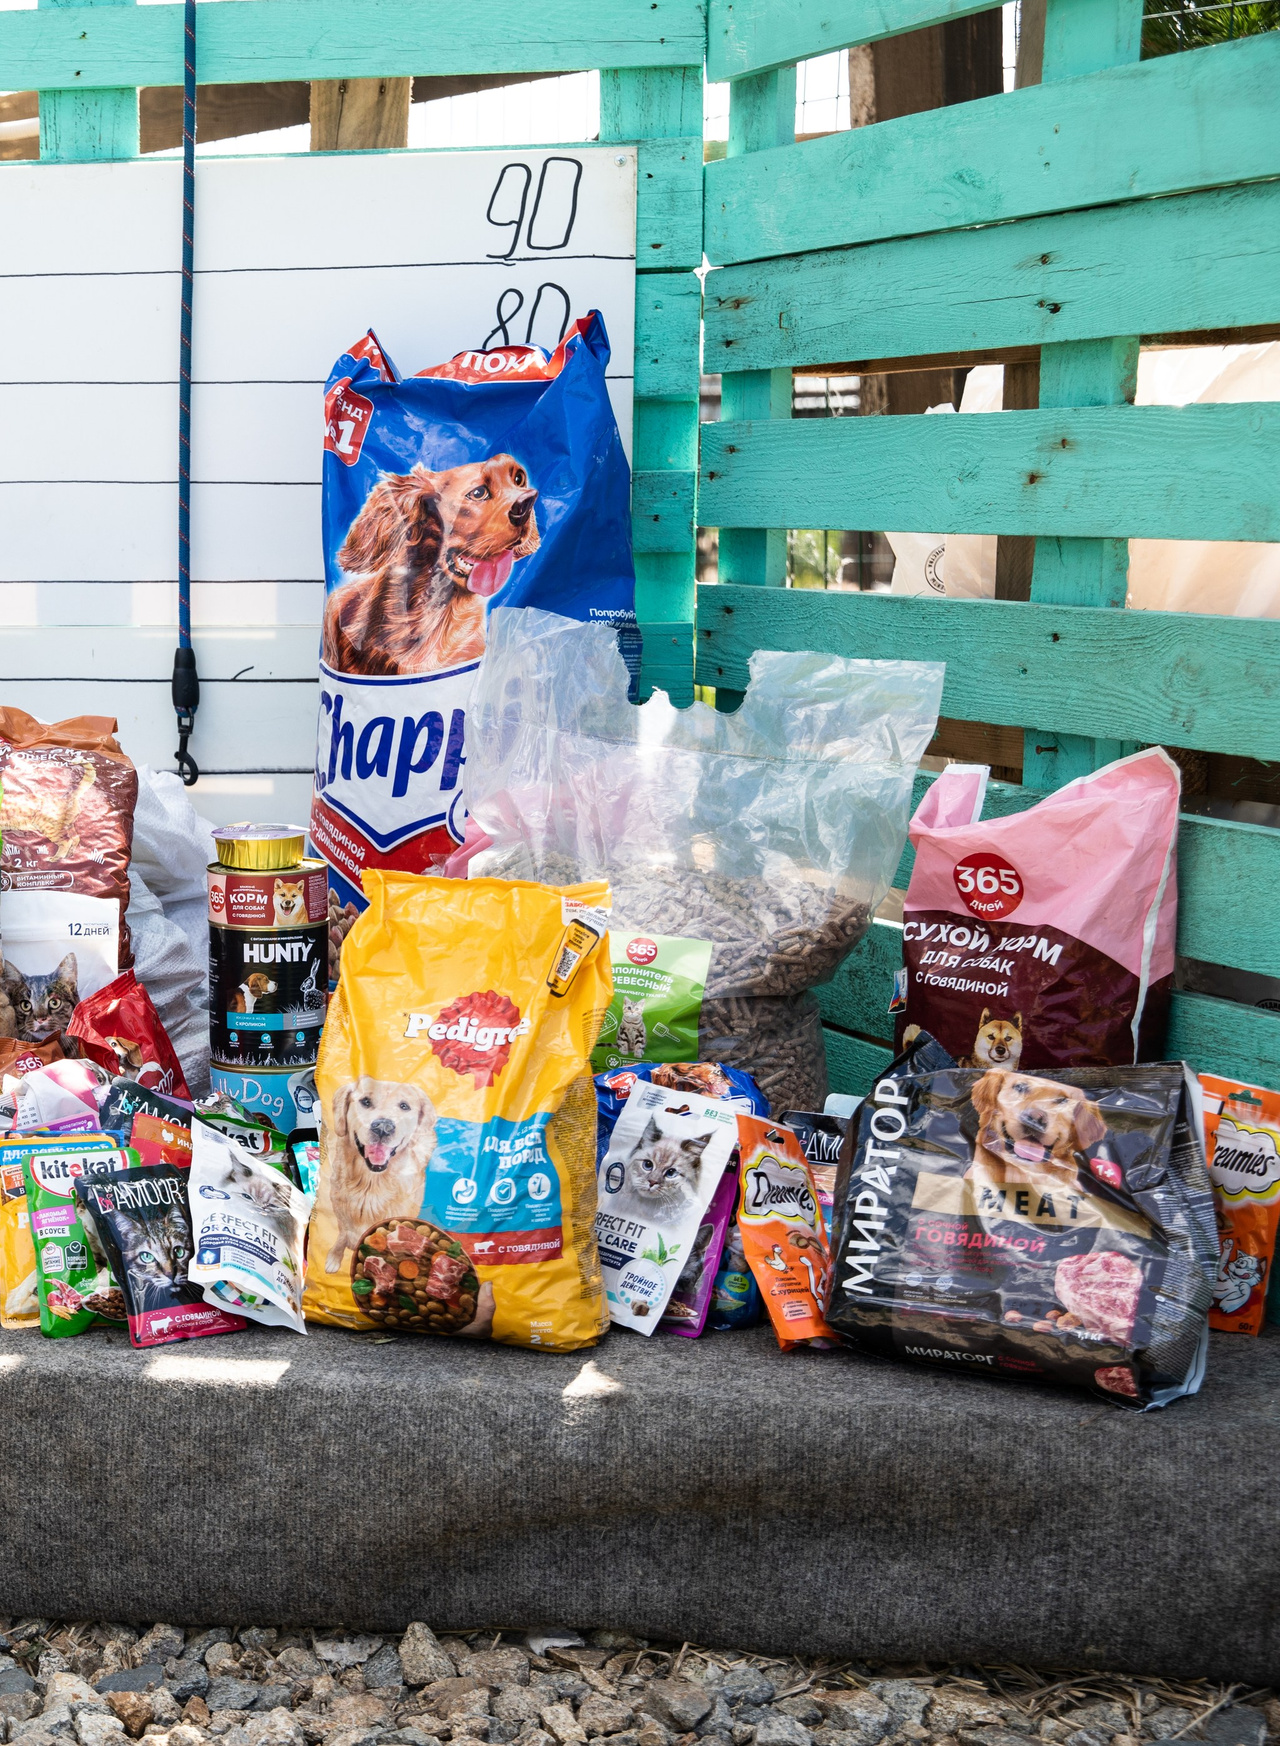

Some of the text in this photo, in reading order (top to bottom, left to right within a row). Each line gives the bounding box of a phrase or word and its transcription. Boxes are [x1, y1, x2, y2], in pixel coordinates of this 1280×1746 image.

[485, 157, 584, 260] 90
[315, 689, 467, 798] Chapp
[319, 812, 366, 862] говядиной
[14, 857, 23, 868] 2
[16, 873, 65, 881] ВИТАМИННЫЙ
[17, 879, 56, 887] КОМПЛЕКС
[956, 865, 1020, 895] 365
[210, 891, 225, 904] 365
[229, 893, 268, 905] КОРМ
[969, 898, 1004, 913] дней
[67, 922, 111, 936] 12 ДНЕЙ
[903, 921, 990, 953] СУХОЙ
[243, 941, 313, 964] HUNTY
[628, 941, 656, 957] 365
[920, 950, 962, 969] ДЛЯ
[915, 971, 1009, 998] С ГОВЯДИНОЙ
[16, 1056, 44, 1071] 365
[241, 1076, 285, 1118] Dog
[705, 1108, 718, 1118] БЕЗ
[2, 1149, 29, 1161] ДЛЯ
[1213, 1144, 1276, 1177] reamies
[39, 1157, 117, 1180] kitekat
[1095, 1164, 1115, 1178] 1+
[842, 1074, 909, 1294] МИРАТОР
[977, 1186, 1086, 1219] MEAT
[45, 1227, 66, 1235] СОУСЕ
[261, 1228, 278, 1246] FIT
[625, 1221, 646, 1239] FIT
[498, 1238, 561, 1254] с говядиной
[605, 1234, 638, 1253] CARE
[915, 1226, 1047, 1254] ГОВЯДИНОЙ
[620, 1280, 654, 1298] ДЕЙСТВИЕ
[624, 1271, 658, 1291] ТРОЙНОЕ
[181, 1309, 222, 1321] ГОВЯДИНОЙ
[530, 1334, 541, 1345] 2
[905, 1345, 994, 1365] МИРАТОРГ
